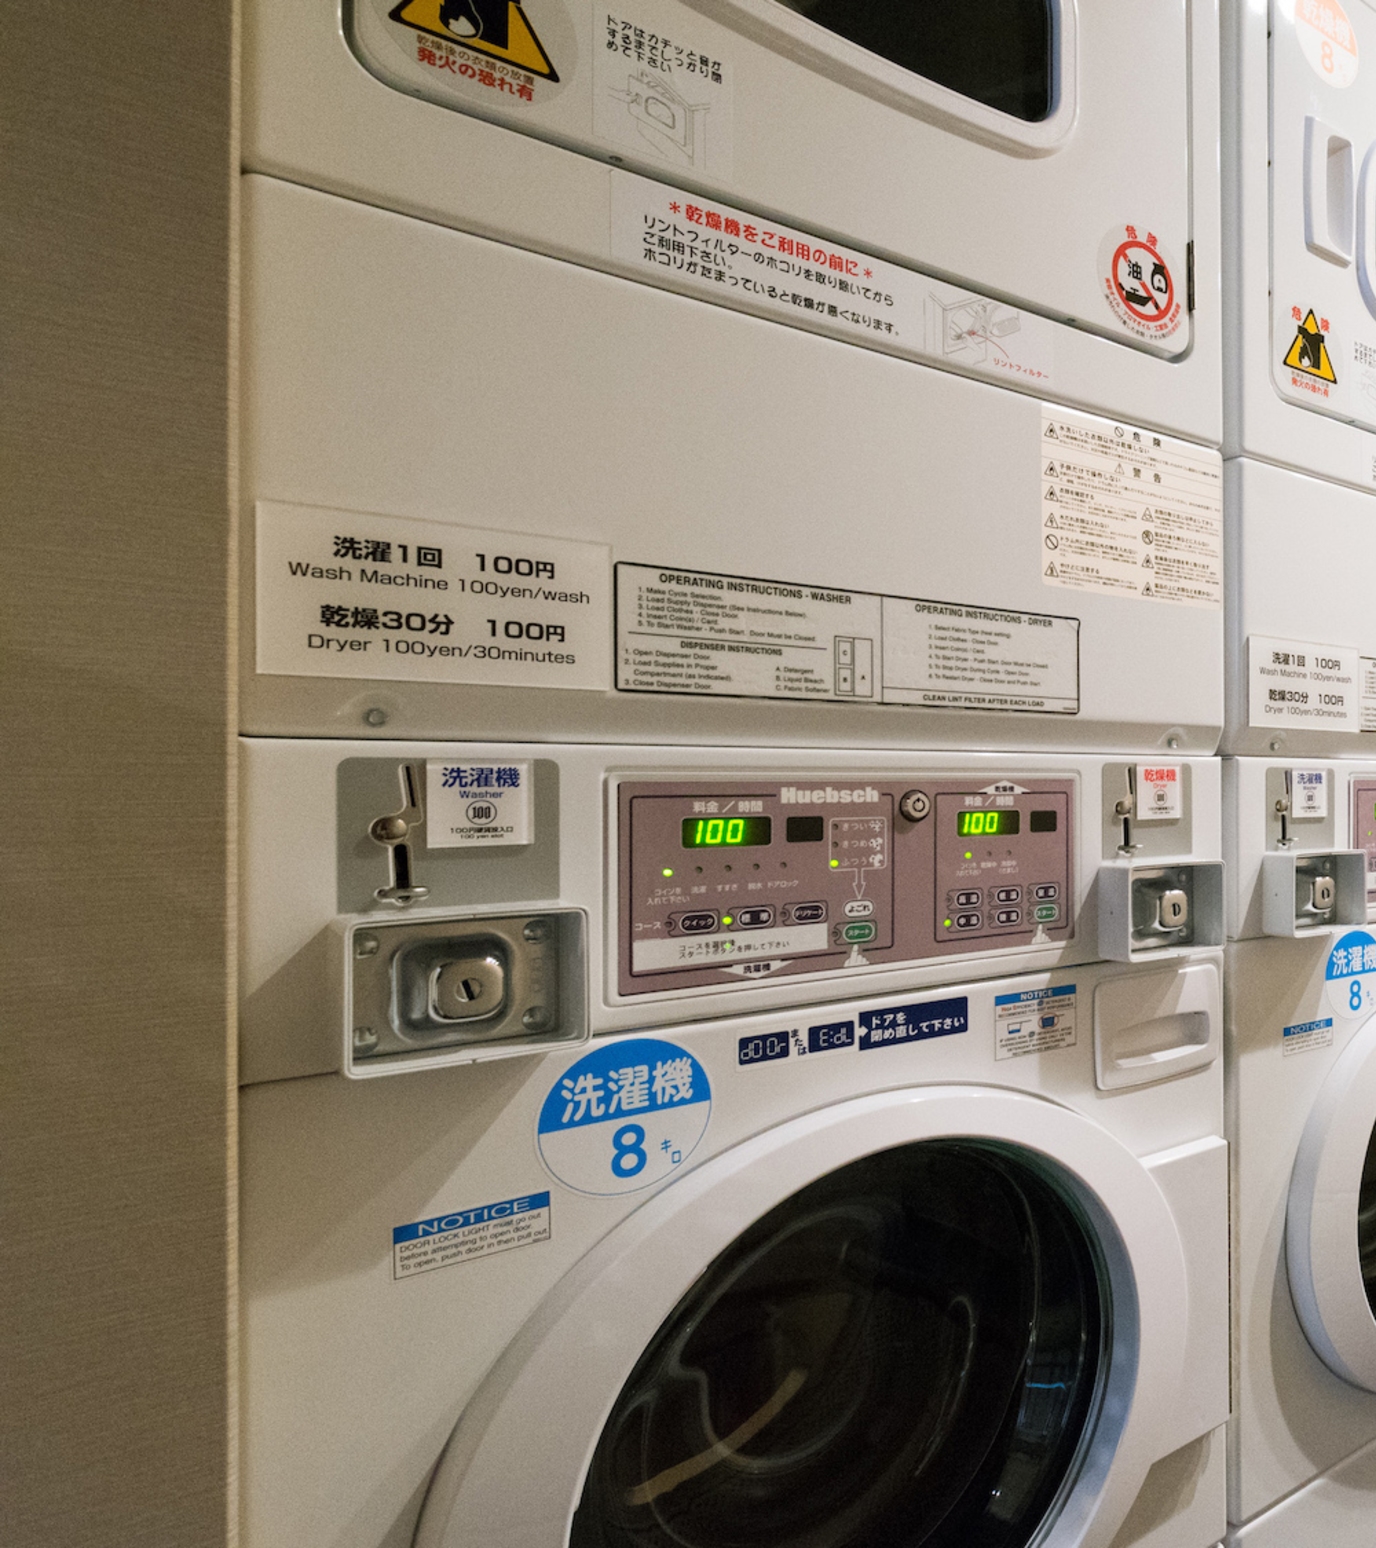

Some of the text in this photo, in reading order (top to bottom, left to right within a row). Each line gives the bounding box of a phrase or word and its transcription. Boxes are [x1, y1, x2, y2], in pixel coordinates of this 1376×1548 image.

[607, 15, 722, 70] ドアはカチッと音が
[606, 40, 672, 74] めて下さい
[607, 27, 722, 84] するまでしっかり閉
[1321, 40, 1334, 74] 8
[416, 46, 533, 101] 発火の恐れ有
[643, 232, 733, 270] ご利用下さい。
[644, 214, 894, 307] リントフィルターのホコリを取り除いてから
[1128, 260, 1142, 280] 油
[993, 357, 1049, 379] リントフィルター
[333, 536, 555, 580] 洗濯1回 100円
[288, 561, 590, 604] Wash Machine 100yen/wash
[659, 573, 852, 604] OPERATING INSTRUCTIONS WASHER
[646, 587, 666, 595] Make
[669, 590, 688, 599] Cycle
[667, 598, 690, 607] Supply
[693, 600, 727, 610] Dispenser
[667, 605, 693, 614] Clothes
[700, 609, 720, 617] Close
[320, 604, 565, 643] 乾燥30分 100円
[646, 613, 665, 621] Insert
[915, 603, 1053, 628] OPERATING INSTRUCTIONS DRYER
[676, 623, 703, 632] Washer
[709, 626, 727, 634] Push
[307, 634, 576, 664] Dryer 100yen/30minutes
[633, 648, 691, 660] Open Dispenser
[680, 640, 782, 656] DISPENSER INSTRUCTIONS
[633, 659, 651, 667] Load
[695, 663, 718, 671] Proper
[1272, 652, 1341, 670] 洗濯1回 100円
[634, 669, 683, 679] Compartment
[1259, 667, 1278, 676] Wash
[1280, 670, 1307, 679] Machine
[633, 679, 692, 690] Close Dispenser
[923, 694, 946, 702] CLEAN
[1269, 689, 1344, 706] 乾燥30分 100円
[1265, 705, 1284, 714] Dryer
[442, 767, 520, 788] 洗濯機
[459, 790, 504, 799] Washer
[780, 787, 879, 804] Huebsch
[472, 806, 491, 819] 100
[695, 819, 745, 844] 100
[963, 812, 998, 834] 100
[848, 903, 871, 913] よごれ
[635, 922, 661, 931] コース
[684, 918, 713, 928] クイック
[848, 927, 871, 937] スタート
[1021, 989, 1053, 1000] NOTICE
[1349, 979, 1362, 1011] 8
[870, 1016, 965, 1043] 閉め直して下さい
[871, 1012, 906, 1028] ドアを
[1289, 1020, 1327, 1036] NOTICE
[561, 1056, 693, 1123] 洗濯機
[611, 1123, 648, 1178] 8
[418, 1198, 530, 1236] NOTICE
[400, 1239, 430, 1253] DOOR
[433, 1232, 460, 1245] LOCK
[462, 1225, 490, 1238] LIGHT
[400, 1250, 429, 1263] before
[490, 1230, 511, 1240] open
[441, 1250, 463, 1262] push
[465, 1245, 486, 1255] door
